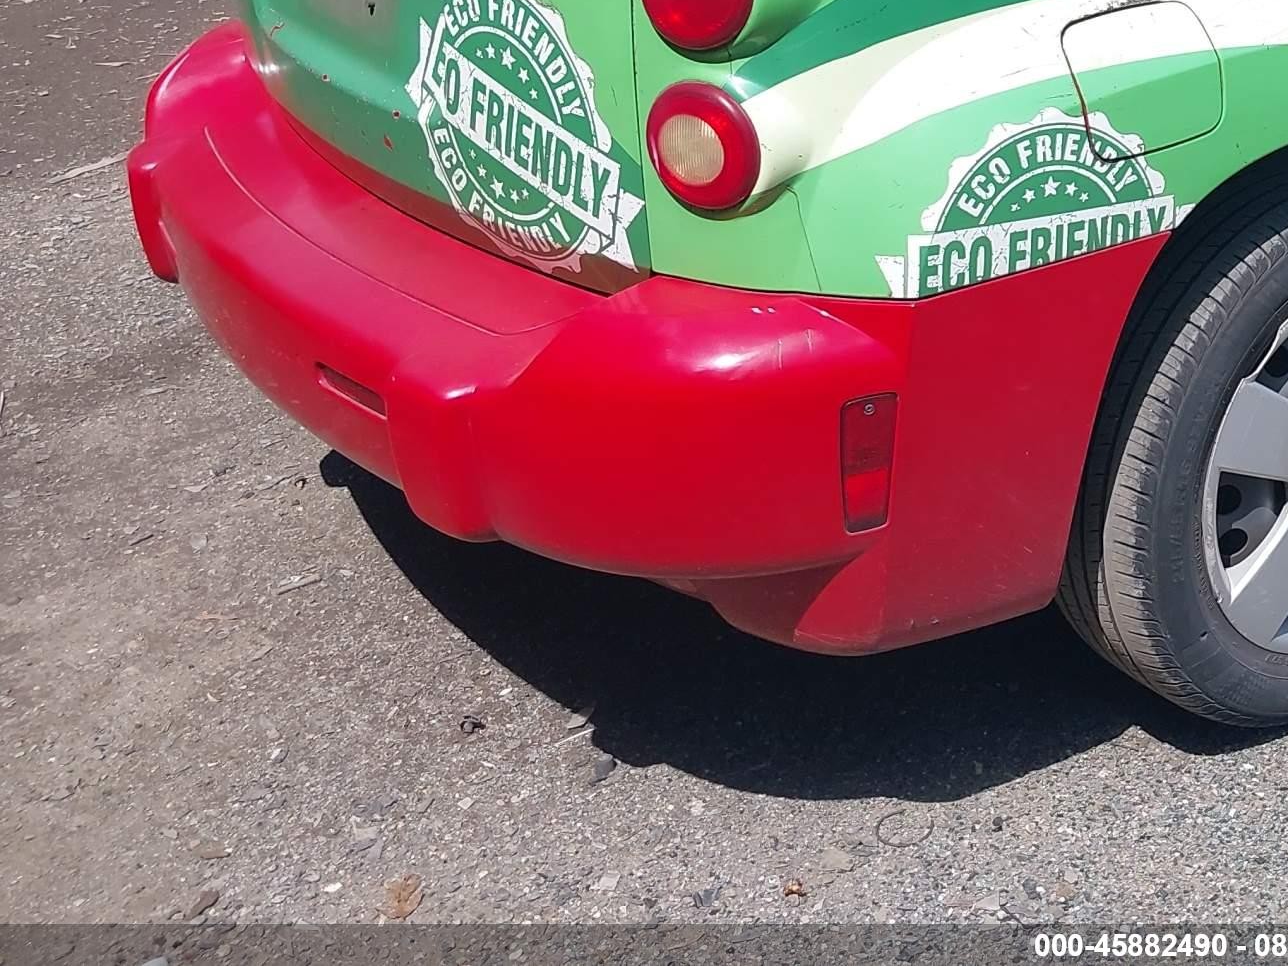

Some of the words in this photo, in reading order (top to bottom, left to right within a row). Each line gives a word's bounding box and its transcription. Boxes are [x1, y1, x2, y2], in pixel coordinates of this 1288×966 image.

[433, 128, 467, 192] ECO
[468, 190, 571, 253] FRIENDLY
[470, 76, 611, 219] FRIENDLY
[957, 156, 1011, 218] ECO
[1016, 133, 1138, 193] FRIENDLY
[918, 235, 993, 298] ECO
